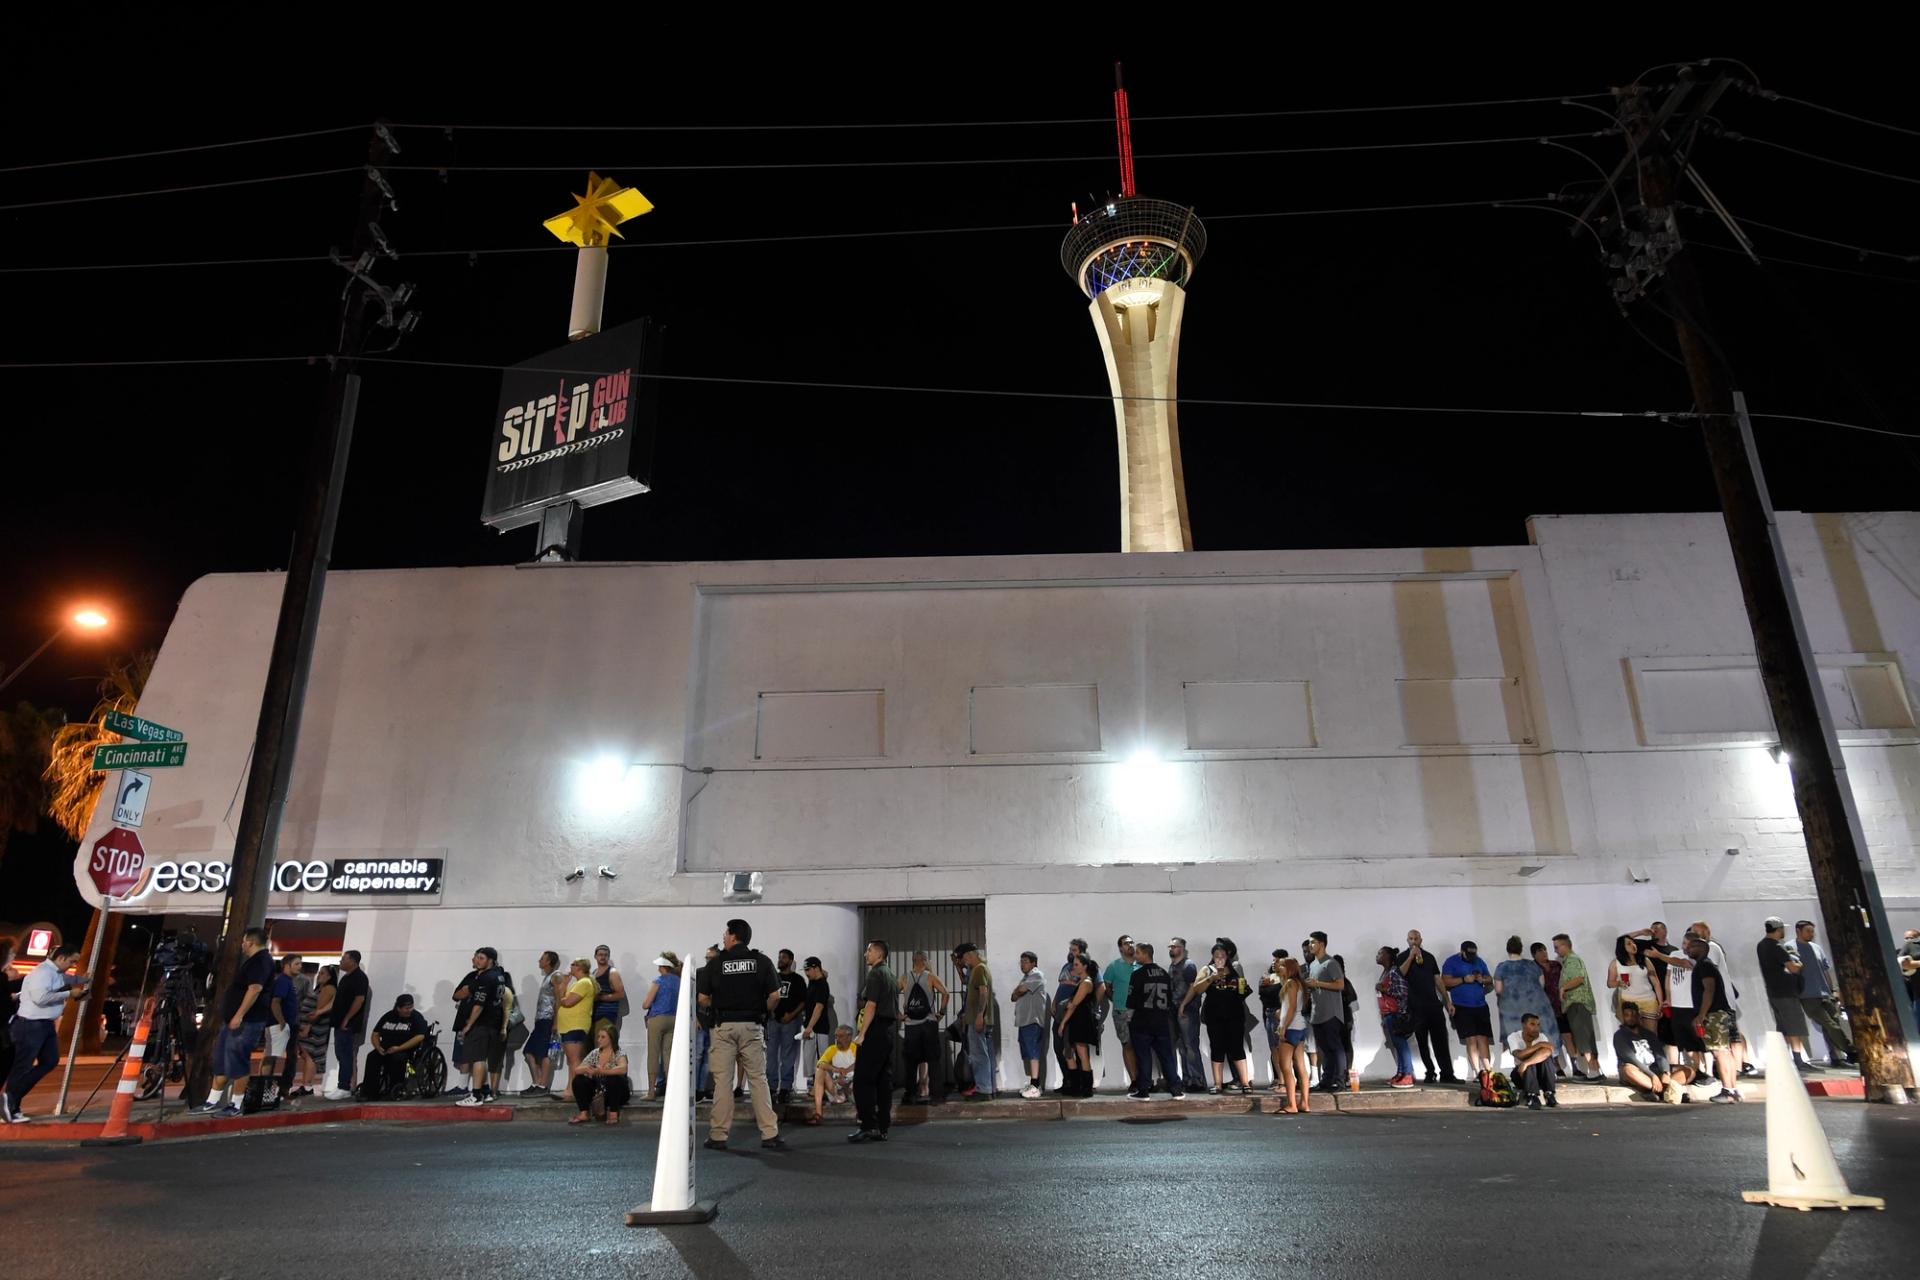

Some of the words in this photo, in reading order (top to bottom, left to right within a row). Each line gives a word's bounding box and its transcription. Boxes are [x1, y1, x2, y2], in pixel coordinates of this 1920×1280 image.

[593, 368, 631, 408] GUN
[113, 713, 135, 730] Las
[137, 719, 165, 740] Vegas
[166, 730, 181, 740] BLVD
[98, 748, 104, 756] E
[105, 748, 166, 765] Cincinnati
[172, 745, 184, 753] AVE
[117, 807, 140, 820] ONLY
[92, 846, 142, 877] STOP
[344, 860, 428, 874] cannabis
[153, 860, 329, 892] essce
[332, 875, 435, 892] dispensary
[724, 961, 755, 973] SECURITY
[1144, 983, 1168, 1008] 75
